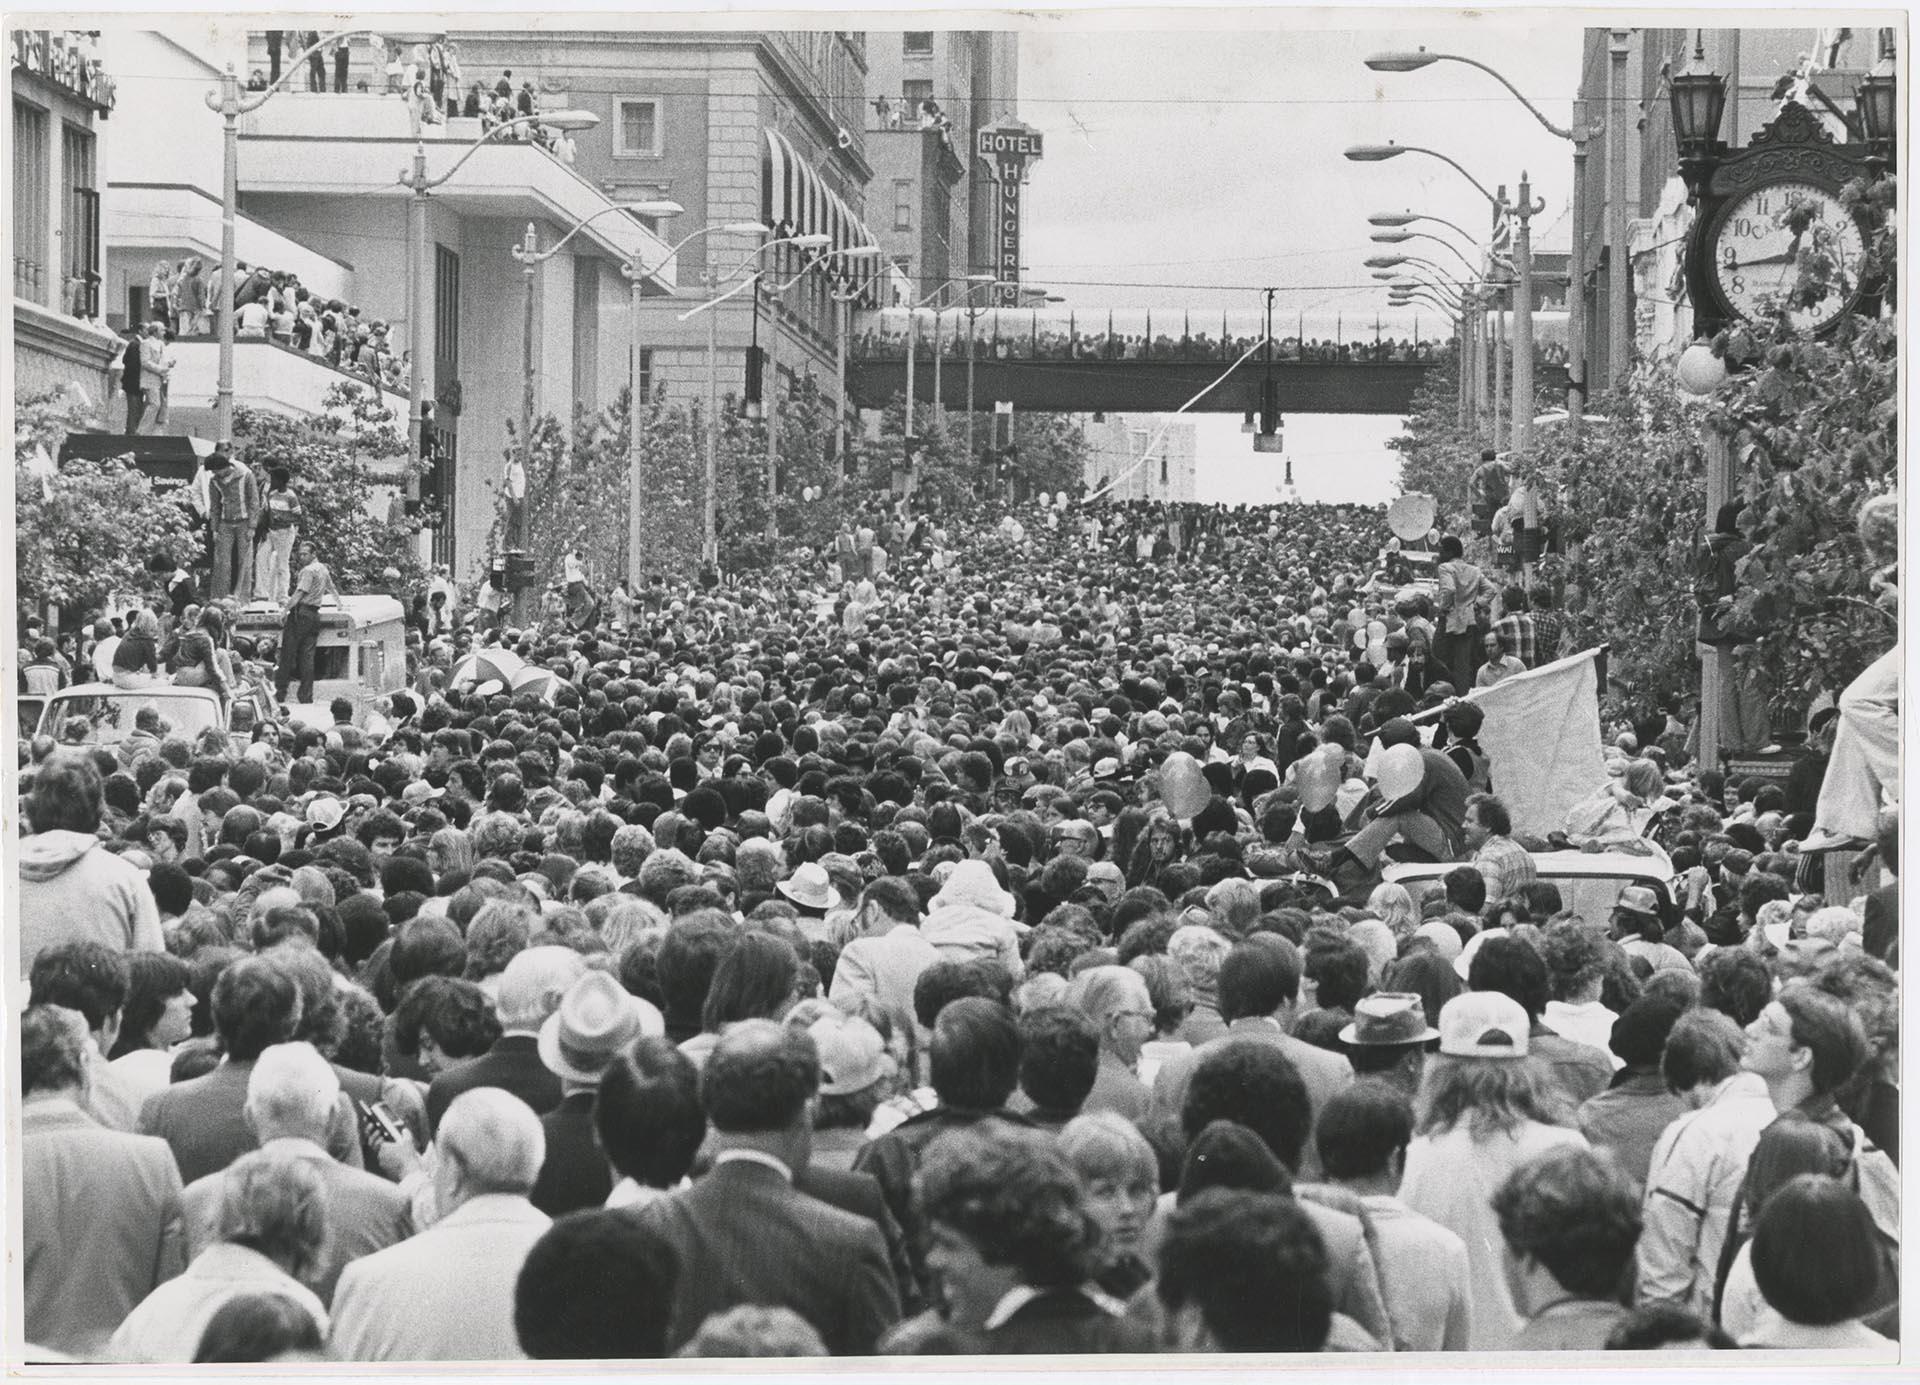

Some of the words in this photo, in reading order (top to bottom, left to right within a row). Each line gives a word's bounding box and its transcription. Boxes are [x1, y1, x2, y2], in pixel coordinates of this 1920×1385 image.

[981, 135, 1041, 153] HOTEL
[1756, 198, 1769, 214] 11
[1734, 218, 1751, 237] 10
[1724, 247, 1736, 265] 9
[1732, 276, 1744, 294] 8
[153, 475, 189, 487] Savings
[1496, 545, 1516, 554] WAI
